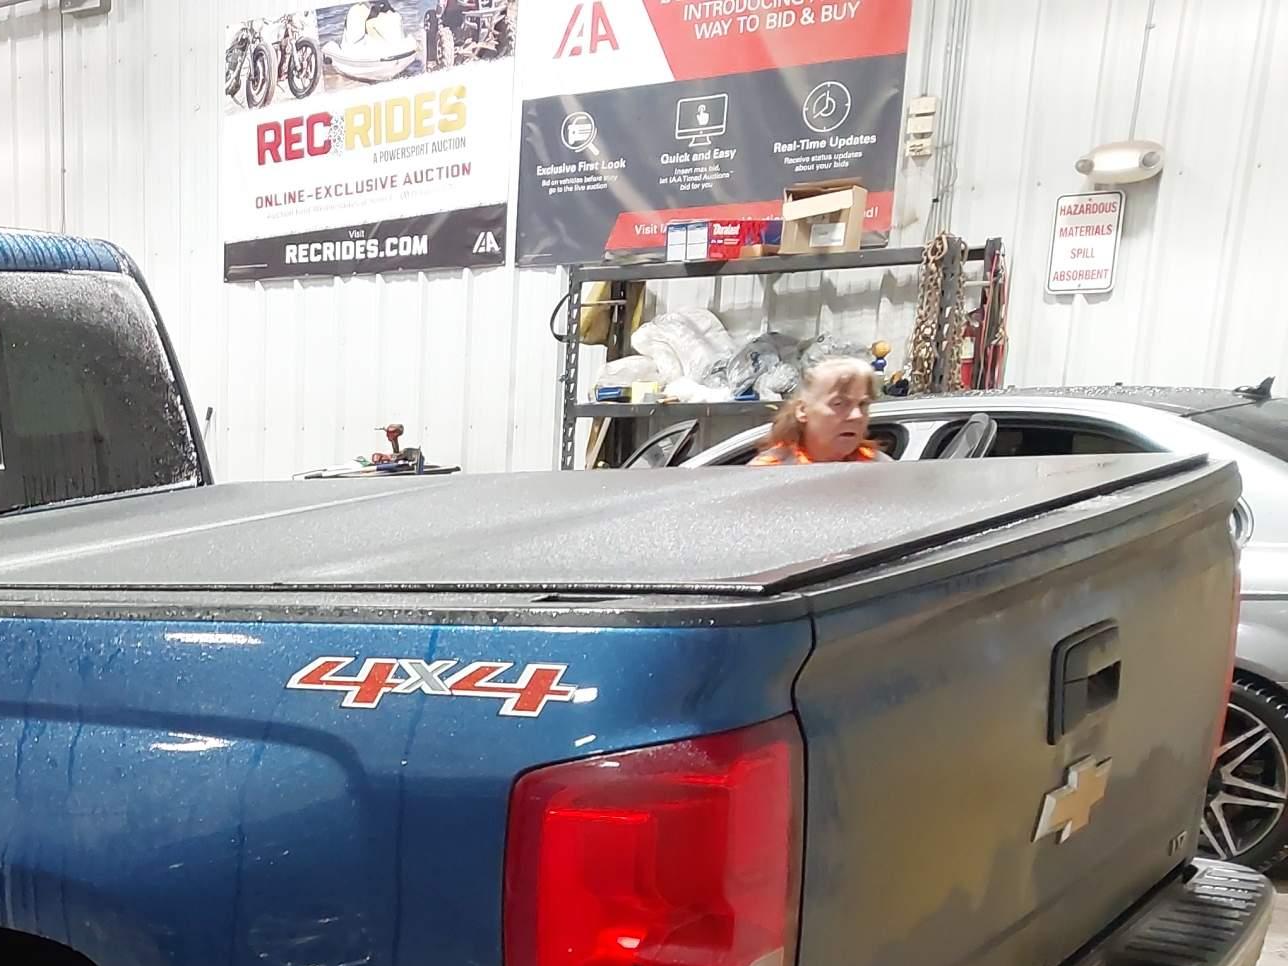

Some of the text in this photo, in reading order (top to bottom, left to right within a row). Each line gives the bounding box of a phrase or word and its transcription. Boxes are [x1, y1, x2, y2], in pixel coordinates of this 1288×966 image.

[694, 1, 860, 40] WAY TO BID & BUY
[257, 84, 467, 166] REC RIDES
[379, 142, 430, 163] POWERSPORT
[431, 136, 467, 155] AUCTION
[773, 134, 877, 153] Real-Time Updates
[660, 148, 737, 164] Quick and Easy
[811, 153, 832, 162] status
[833, 151, 863, 160] updates
[536, 158, 626, 176] Exclusive First Look
[794, 160, 849, 172] about your bids
[255, 174, 398, 210] ONLINE-EXCLUSIVE
[402, 162, 472, 186] AUCTION
[564, 184, 573, 192] the
[1059, 201, 1118, 216] HAZARDOUS
[348, 230, 365, 239] Visit
[634, 223, 658, 235] Visit
[1059, 223, 1113, 238] MATERIALS
[285, 234, 429, 265] RECRIDES.COM
[1070, 247, 1095, 259] SPILL
[1052, 268, 1110, 281] ABSORBENT
